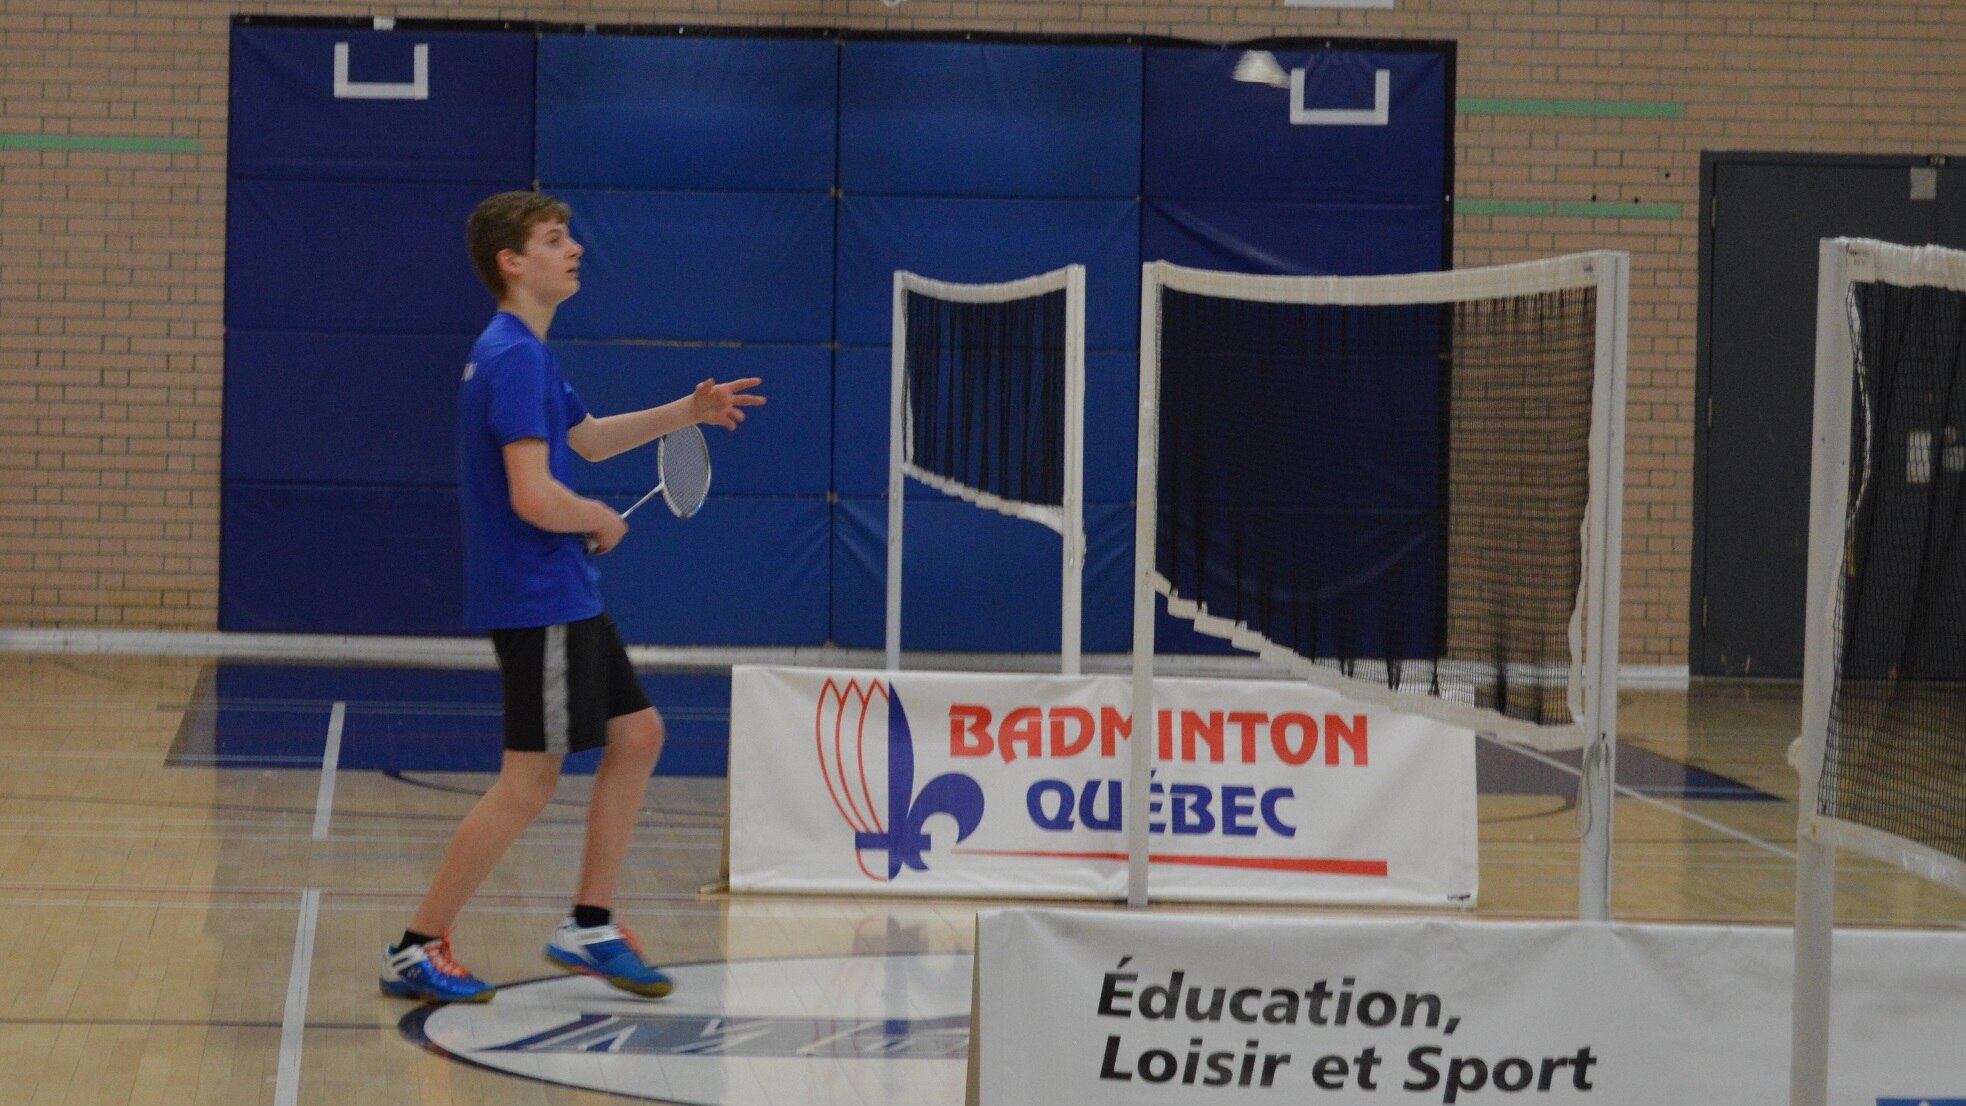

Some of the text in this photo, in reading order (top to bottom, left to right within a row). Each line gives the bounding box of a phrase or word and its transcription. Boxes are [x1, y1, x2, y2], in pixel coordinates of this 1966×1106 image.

[948, 703, 1369, 767] BADMINTON
[1097, 955, 1461, 1035] Éducation,
[1099, 1034, 1598, 1106] Loisir et Sport
